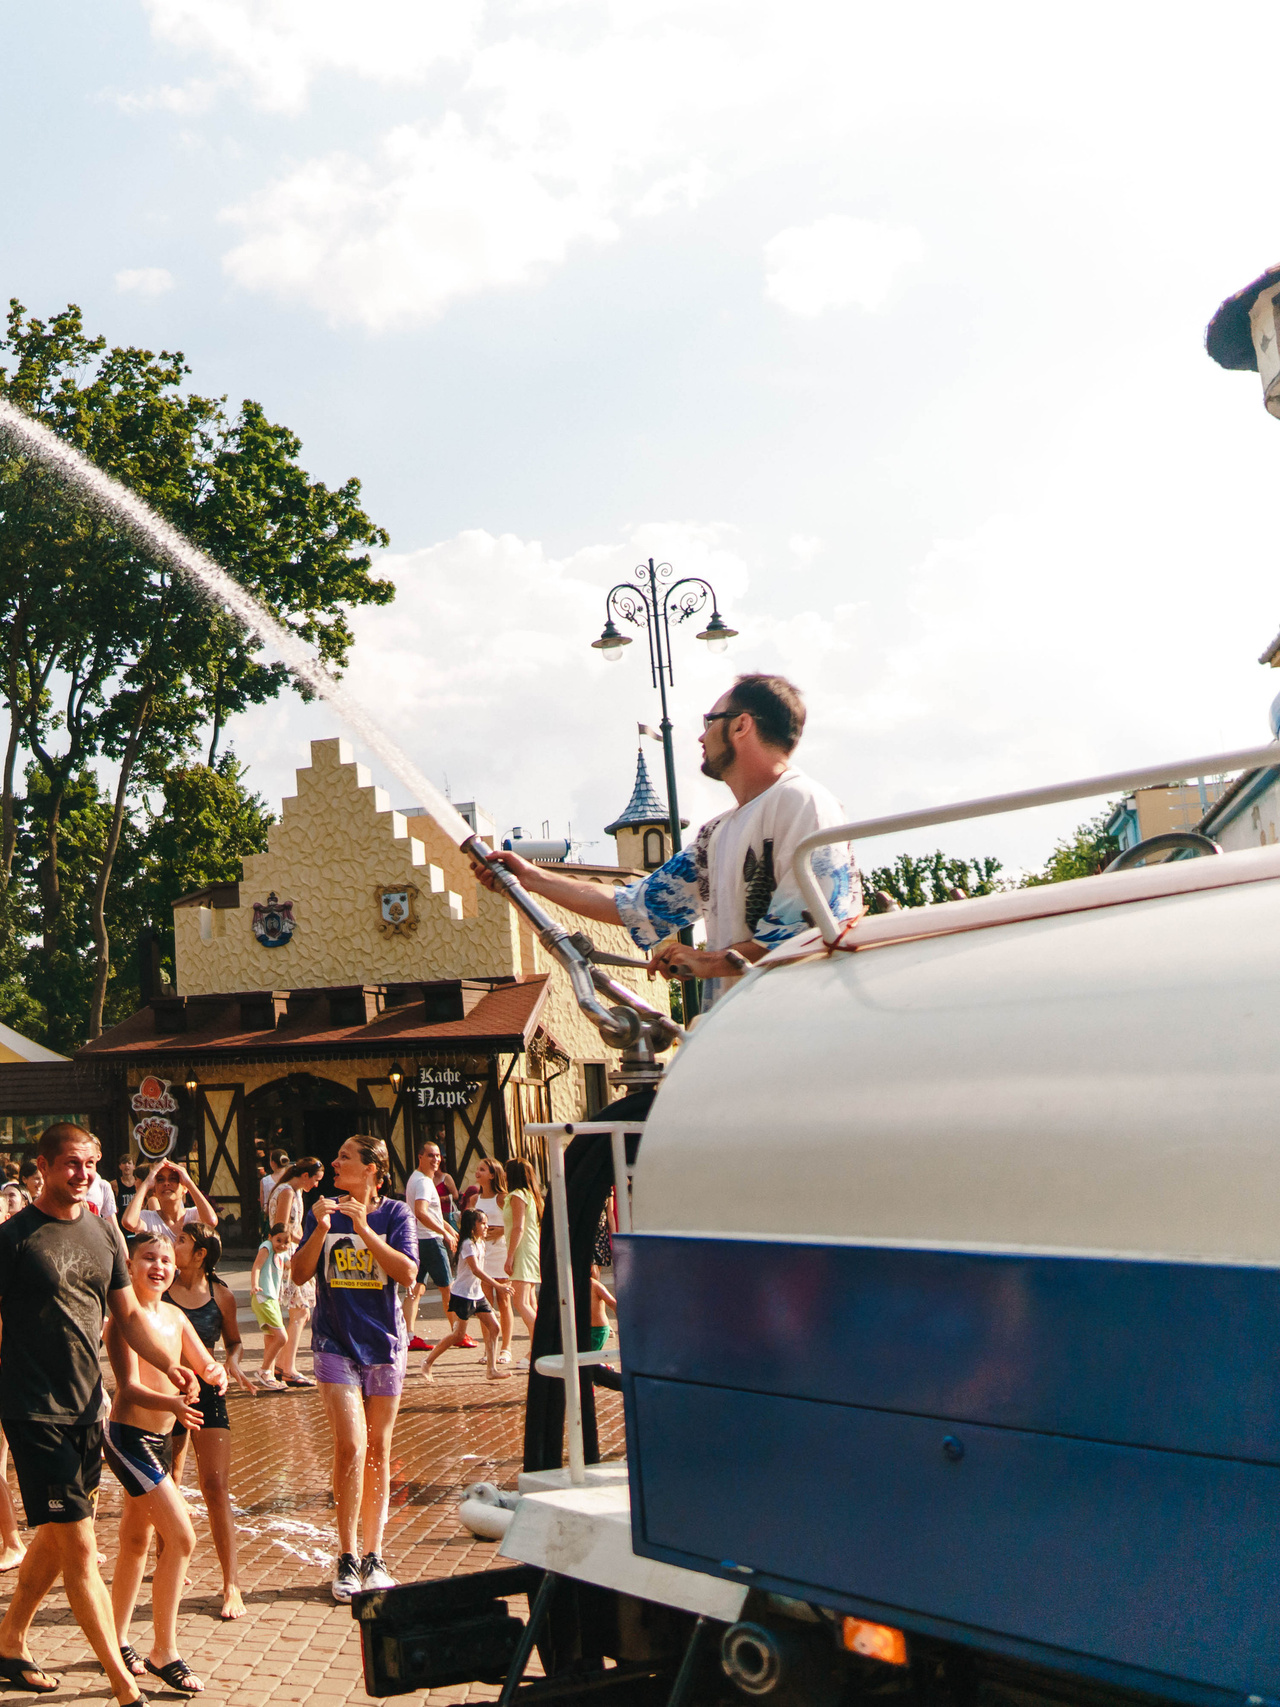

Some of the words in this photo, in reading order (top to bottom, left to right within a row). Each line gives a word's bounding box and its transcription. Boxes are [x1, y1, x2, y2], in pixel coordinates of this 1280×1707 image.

[420, 1068, 461, 1085] Кафе
[133, 1094, 173, 1110] Steak
[334, 1248, 373, 1272] BEST
